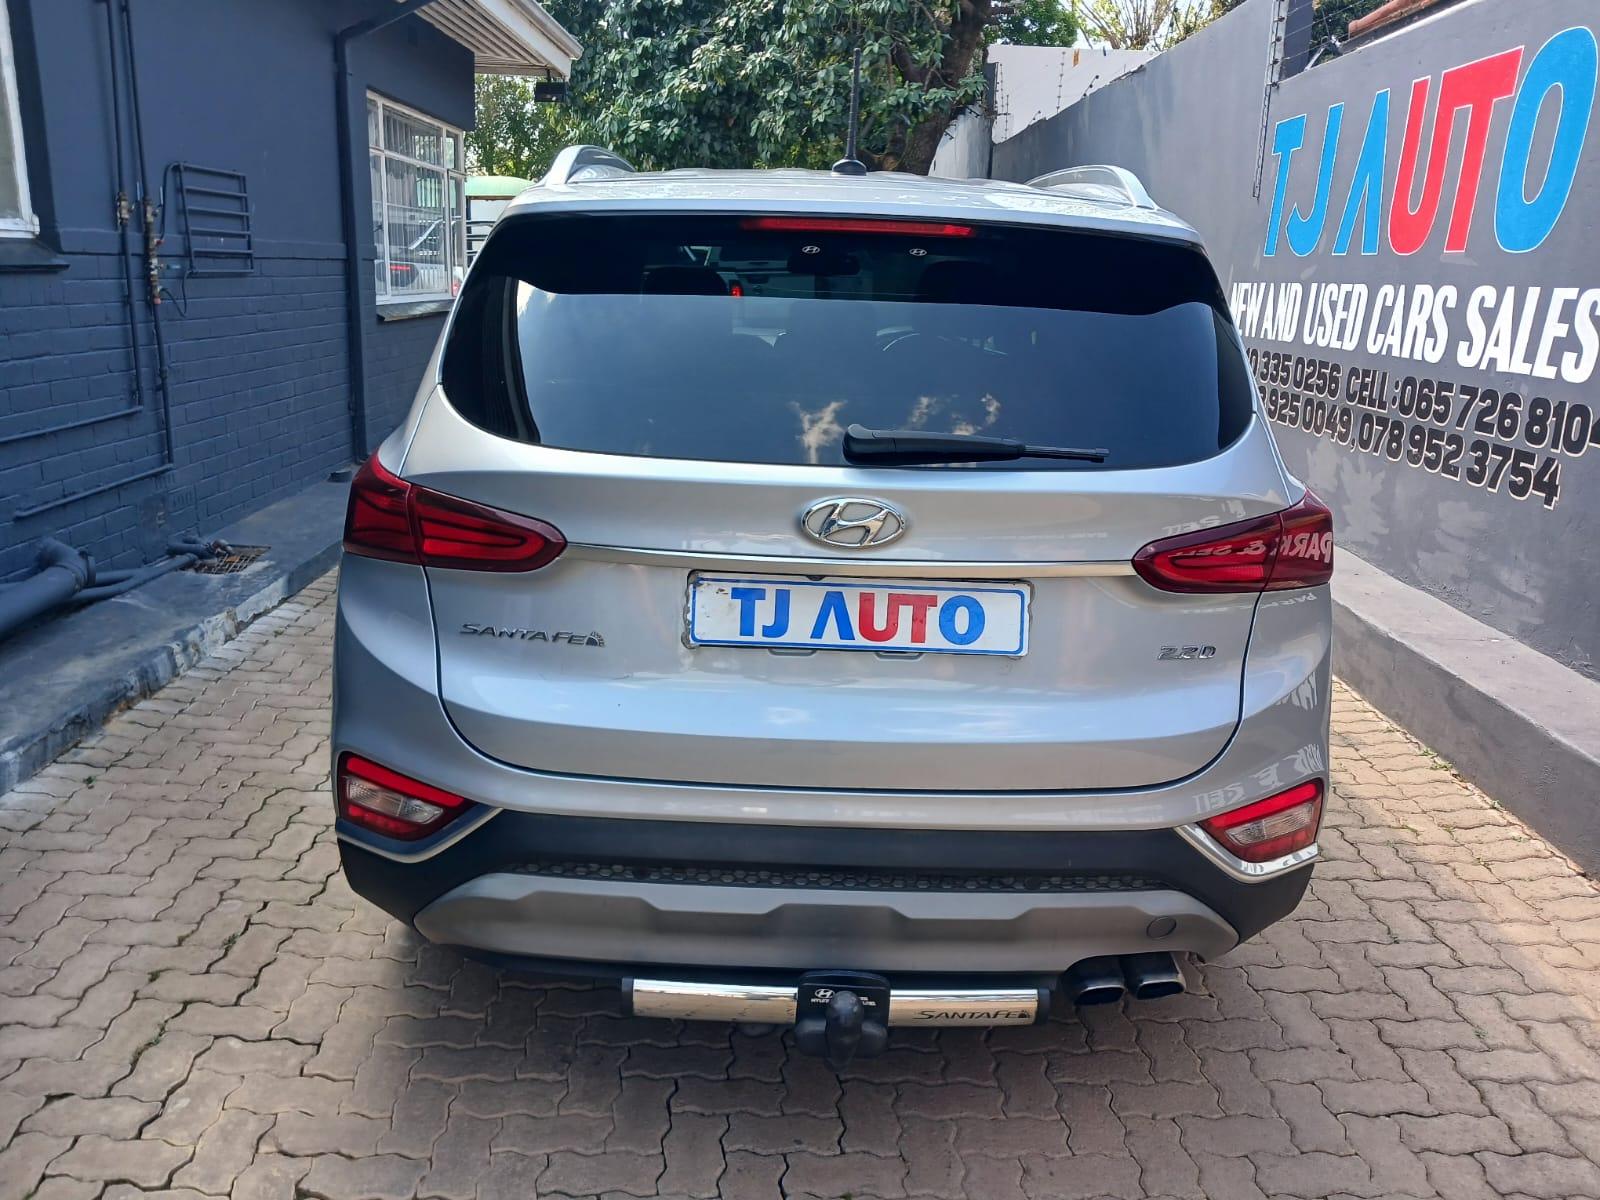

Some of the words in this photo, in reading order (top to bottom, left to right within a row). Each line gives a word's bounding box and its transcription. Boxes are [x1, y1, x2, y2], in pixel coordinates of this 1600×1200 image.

[1264, 102, 1344, 257] TJ
[1332, 26, 1598, 256] AUTO
[1230, 282, 1266, 338] NEW
[1260, 282, 1303, 343] AND
[1303, 282, 1369, 352] USED
[1367, 284, 1457, 364] CARS
[1456, 285, 1600, 384] SALES
[1260, 350, 1293, 388] 335
[1293, 356, 1343, 401] 0256
[1345, 367, 1391, 412] CELL
[1456, 385, 1524, 441] 726
[1267, 387, 1302, 430] 925
[1358, 412, 1405, 463] 078
[1406, 424, 1466, 481] 952
[1466, 439, 1561, 510] 3754
[731, 587, 790, 639] TJ
[810, 591, 986, 645] AUTO
